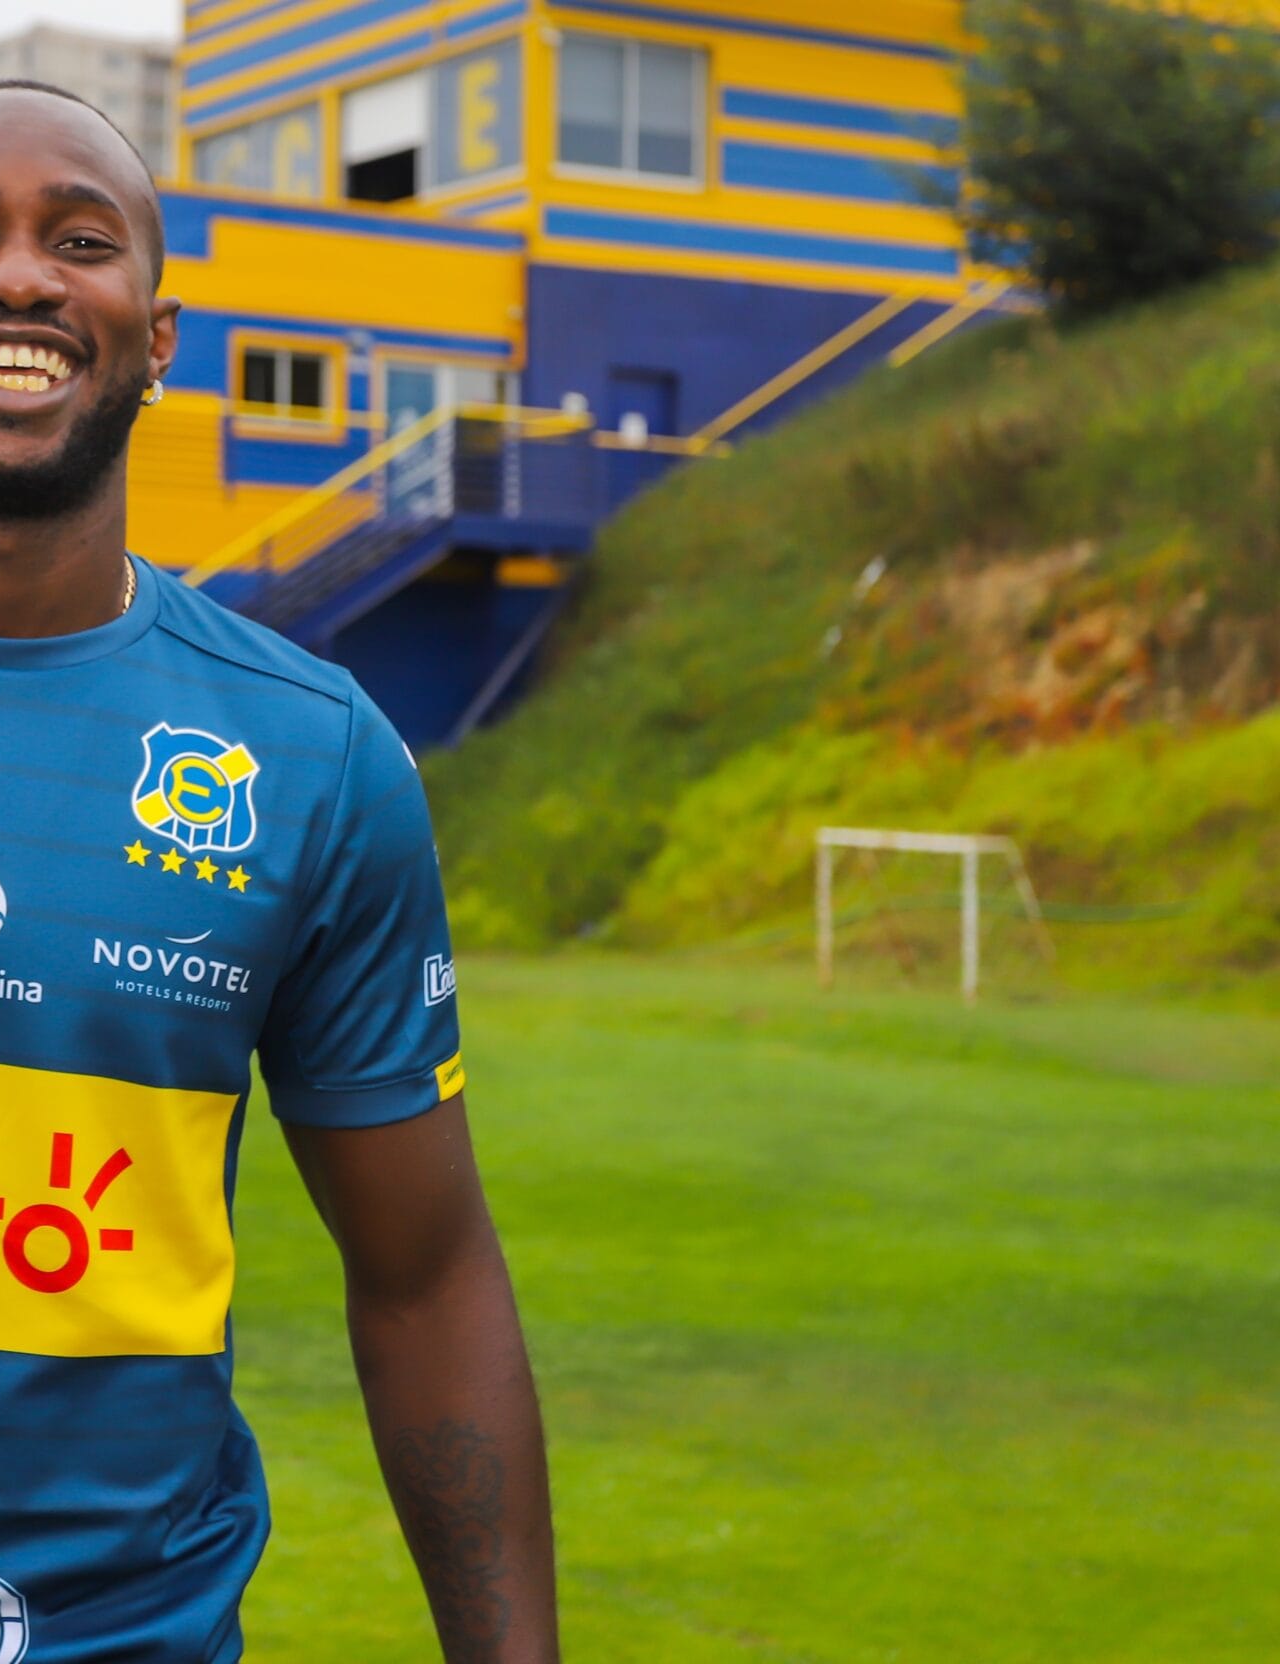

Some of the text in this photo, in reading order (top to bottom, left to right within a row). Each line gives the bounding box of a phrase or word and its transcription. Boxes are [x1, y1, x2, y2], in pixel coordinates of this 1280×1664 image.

[93, 937, 251, 994] NOVOTEL
[115, 979, 232, 1013] HOTELS & RESORTS
